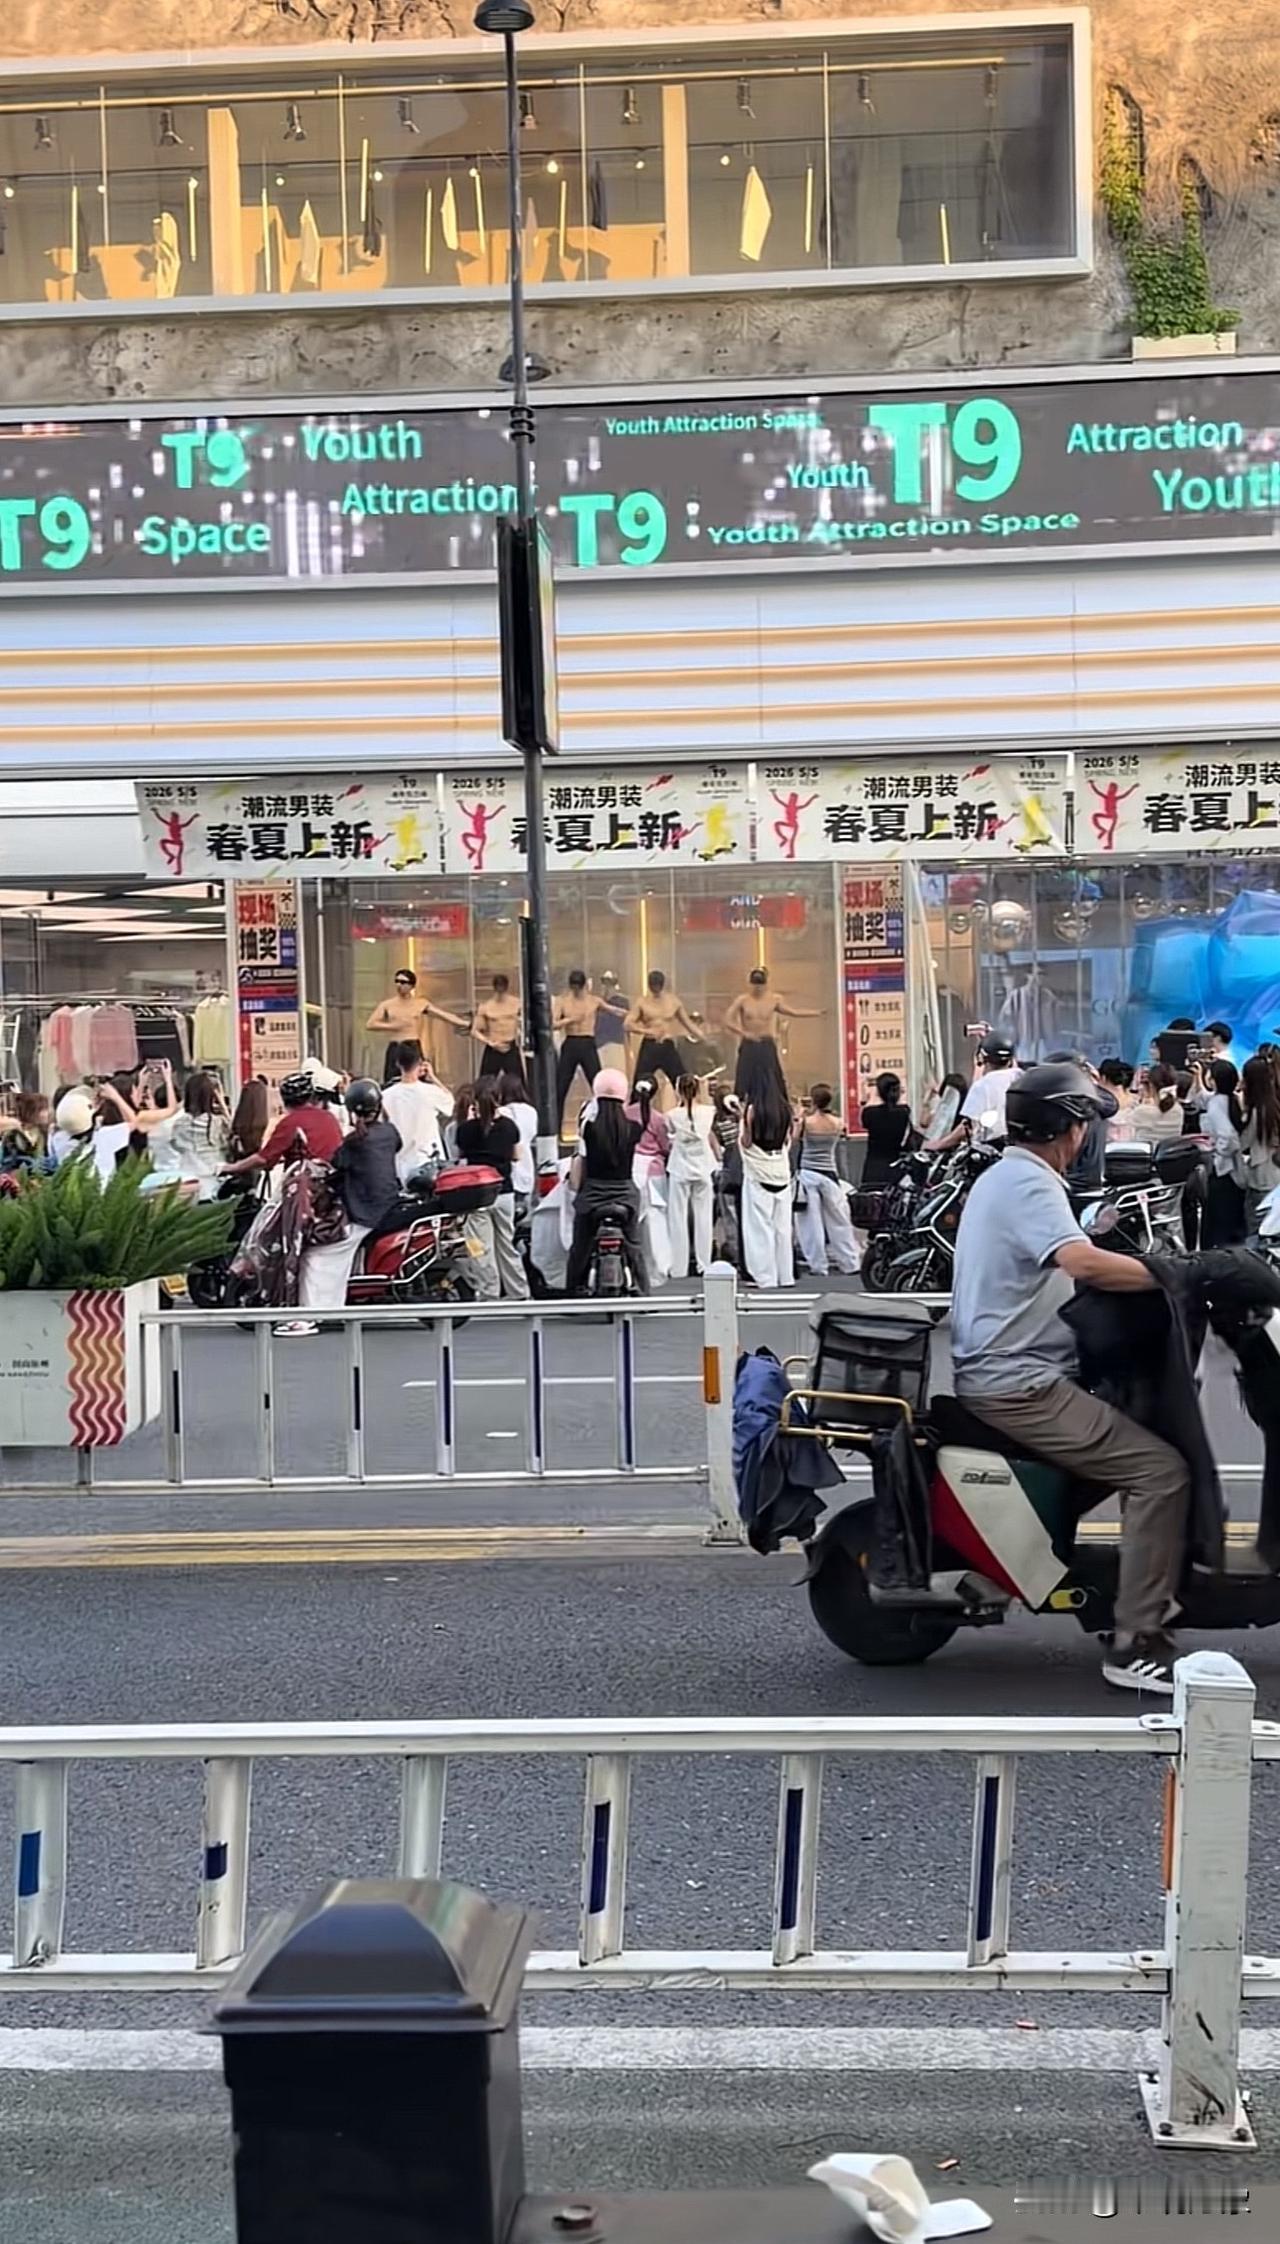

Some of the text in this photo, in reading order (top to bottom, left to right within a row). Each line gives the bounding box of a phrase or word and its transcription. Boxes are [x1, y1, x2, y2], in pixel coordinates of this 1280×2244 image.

[606, 415, 660, 436] Youth
[662, 412, 757, 433] Attraction
[1066, 415, 1243, 455] Attraction
[302, 424, 423, 462] Youth
[868, 398, 1021, 504] T9
[161, 430, 248, 489] T9
[787, 461, 870, 488] Youth
[340, 478, 518, 515] Attraction
[0, 496, 90, 570] T9
[140, 516, 271, 564] Space
[560, 490, 668, 568] T9
[707, 511, 1080, 544] Youth Attraction Space
[765, 767, 795, 778] 2026
[1082, 757, 1114, 769] 2026
[1184, 761, 1280, 788] 潮流男装
[144, 787, 173, 798] 2026
[452, 777, 482, 789] 2026
[549, 784, 643, 810] 潮流男装
[863, 774, 959, 799] 潮流男装
[241, 794, 335, 819] 潮流男装
[823, 801, 998, 843] 春夏上新
[1143, 790, 1280, 834] 春夏上
[205, 822, 374, 862] 春夏上新
[238, 893, 277, 925] 现场
[845, 880, 884, 908] 现场
[846, 912, 884, 942] 抽奖
[239, 927, 277, 960] 抽奖
